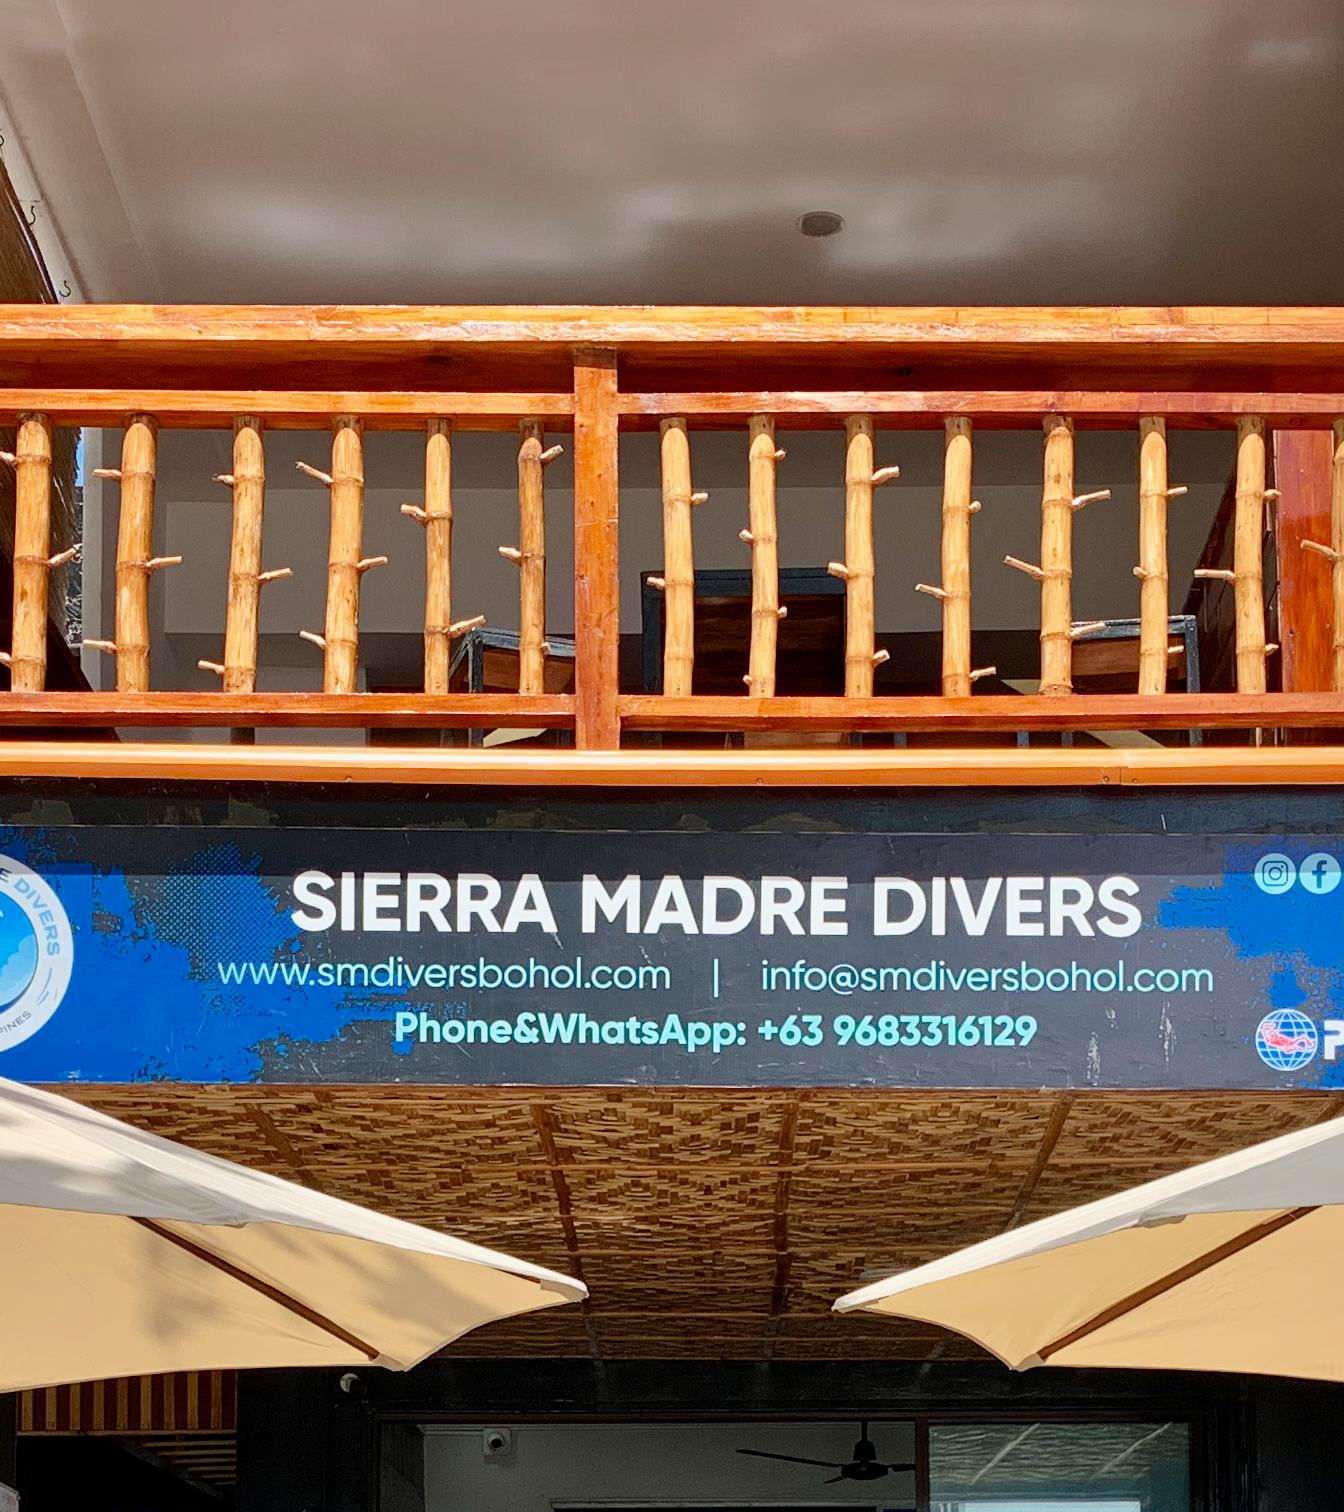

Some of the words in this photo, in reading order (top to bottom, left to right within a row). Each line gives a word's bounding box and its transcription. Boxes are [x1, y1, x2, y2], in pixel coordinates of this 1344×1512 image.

[14, 878, 60, 956] DIVERS
[292, 870, 558, 933] SIERRA
[582, 874, 848, 936] MADRE
[873, 875, 1142, 938] DIVERS
[218, 957, 670, 991] www.smdiversbohol.com
[762, 960, 1213, 995] info@smdiversbohol.com
[396, 1011, 746, 1053] Phone&WhatsApp:
[757, 1014, 823, 1047] +63
[833, 1014, 1038, 1047] 9683316129
